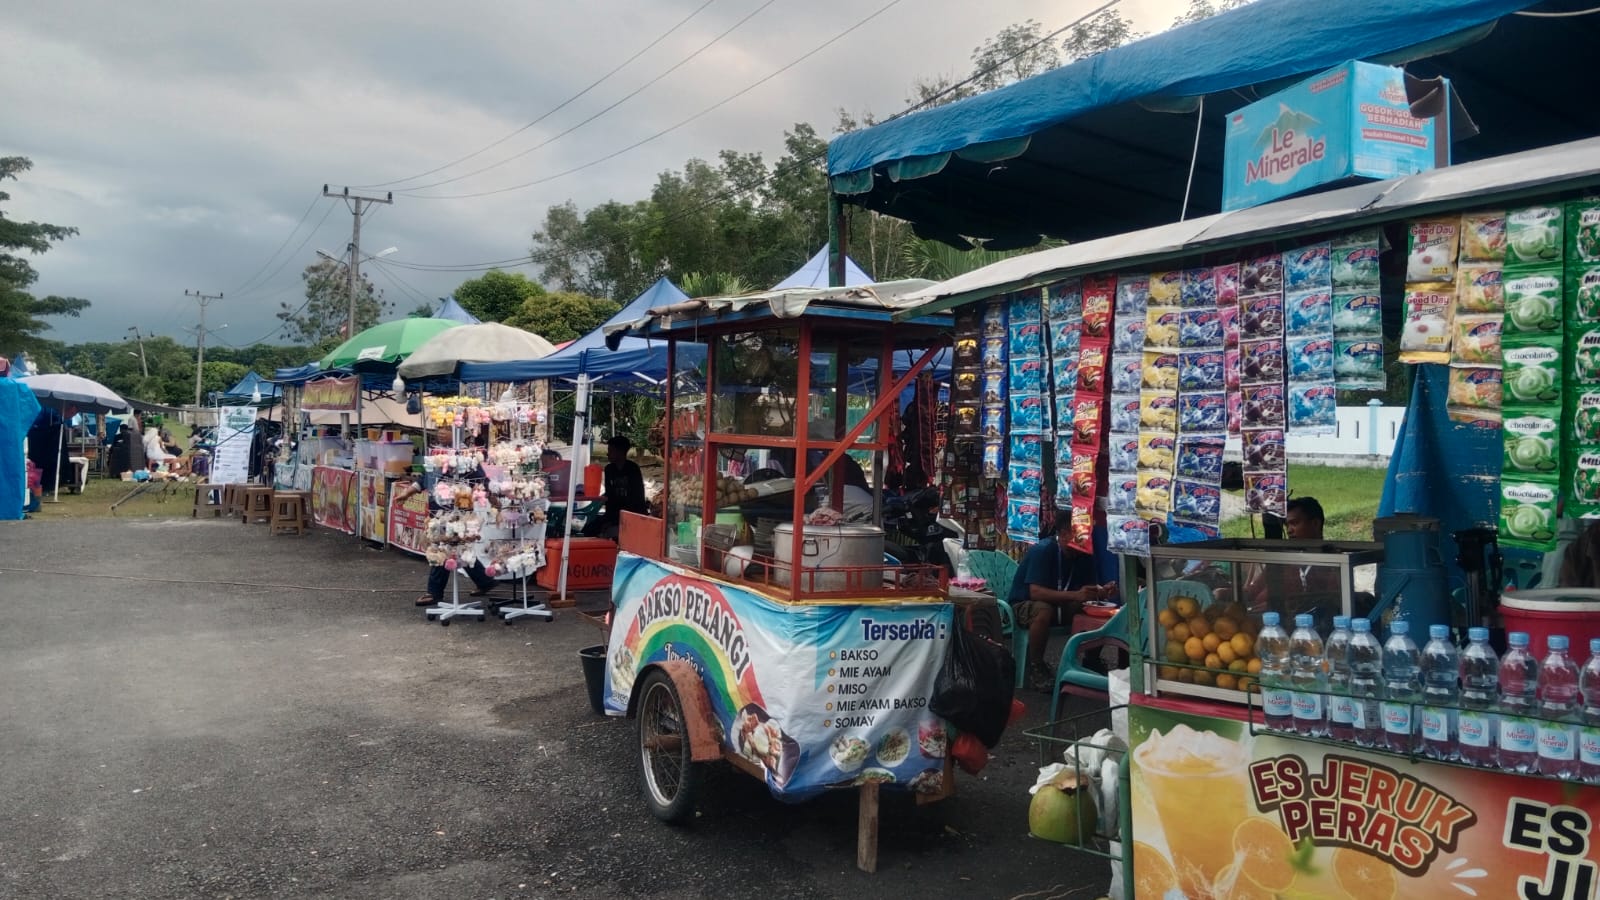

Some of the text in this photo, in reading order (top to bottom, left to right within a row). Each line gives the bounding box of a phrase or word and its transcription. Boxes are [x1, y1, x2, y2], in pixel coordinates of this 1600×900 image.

[1273, 128, 1293, 153] Le
[1246, 138, 1325, 184] Minerale
[1411, 224, 1454, 236] Good Day
[1407, 294, 1449, 306] Good Day
[637, 586, 751, 681] BAKSO PELANGI
[861, 618, 936, 641] Tersedia
[840, 648, 880, 662] BAKSO
[840, 665, 893, 679] MIE AYAM
[838, 683, 868, 696] MISO
[837, 696, 928, 713] MIE AYAM BAKSO
[835, 715, 876, 729] SOMAY
[1250, 757, 1473, 844] ES JERUK
[1280, 799, 1434, 869] PERAS
[1508, 801, 1589, 857] ES
